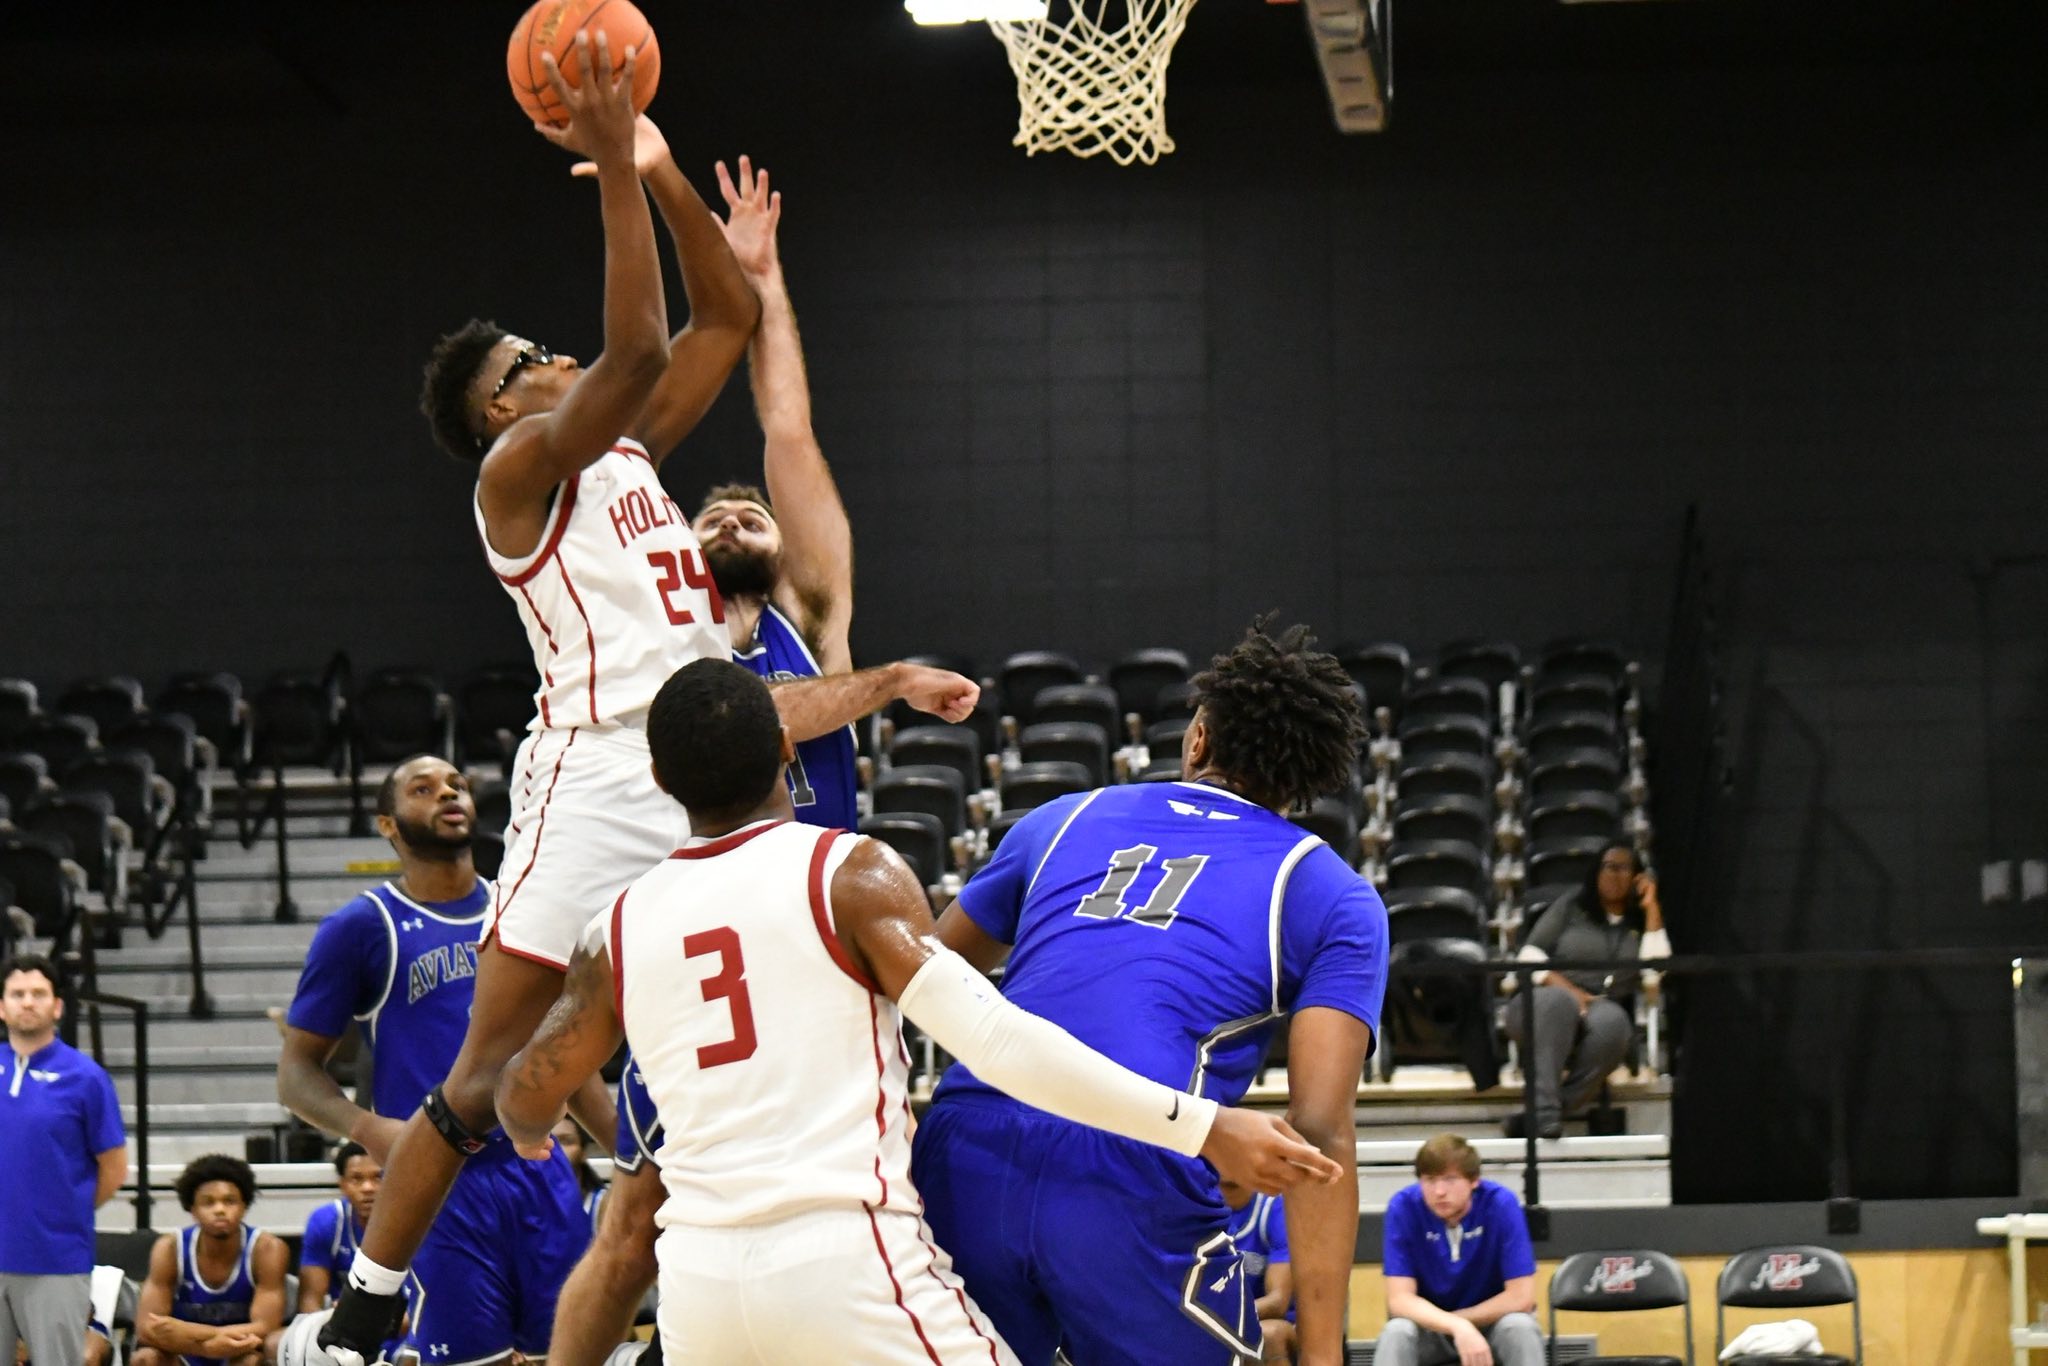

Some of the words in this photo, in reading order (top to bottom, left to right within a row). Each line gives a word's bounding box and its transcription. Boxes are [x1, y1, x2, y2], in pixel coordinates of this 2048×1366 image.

[646, 548, 726, 626] 24
[1072, 843, 1211, 931] 11
[683, 925, 758, 1070] 3
